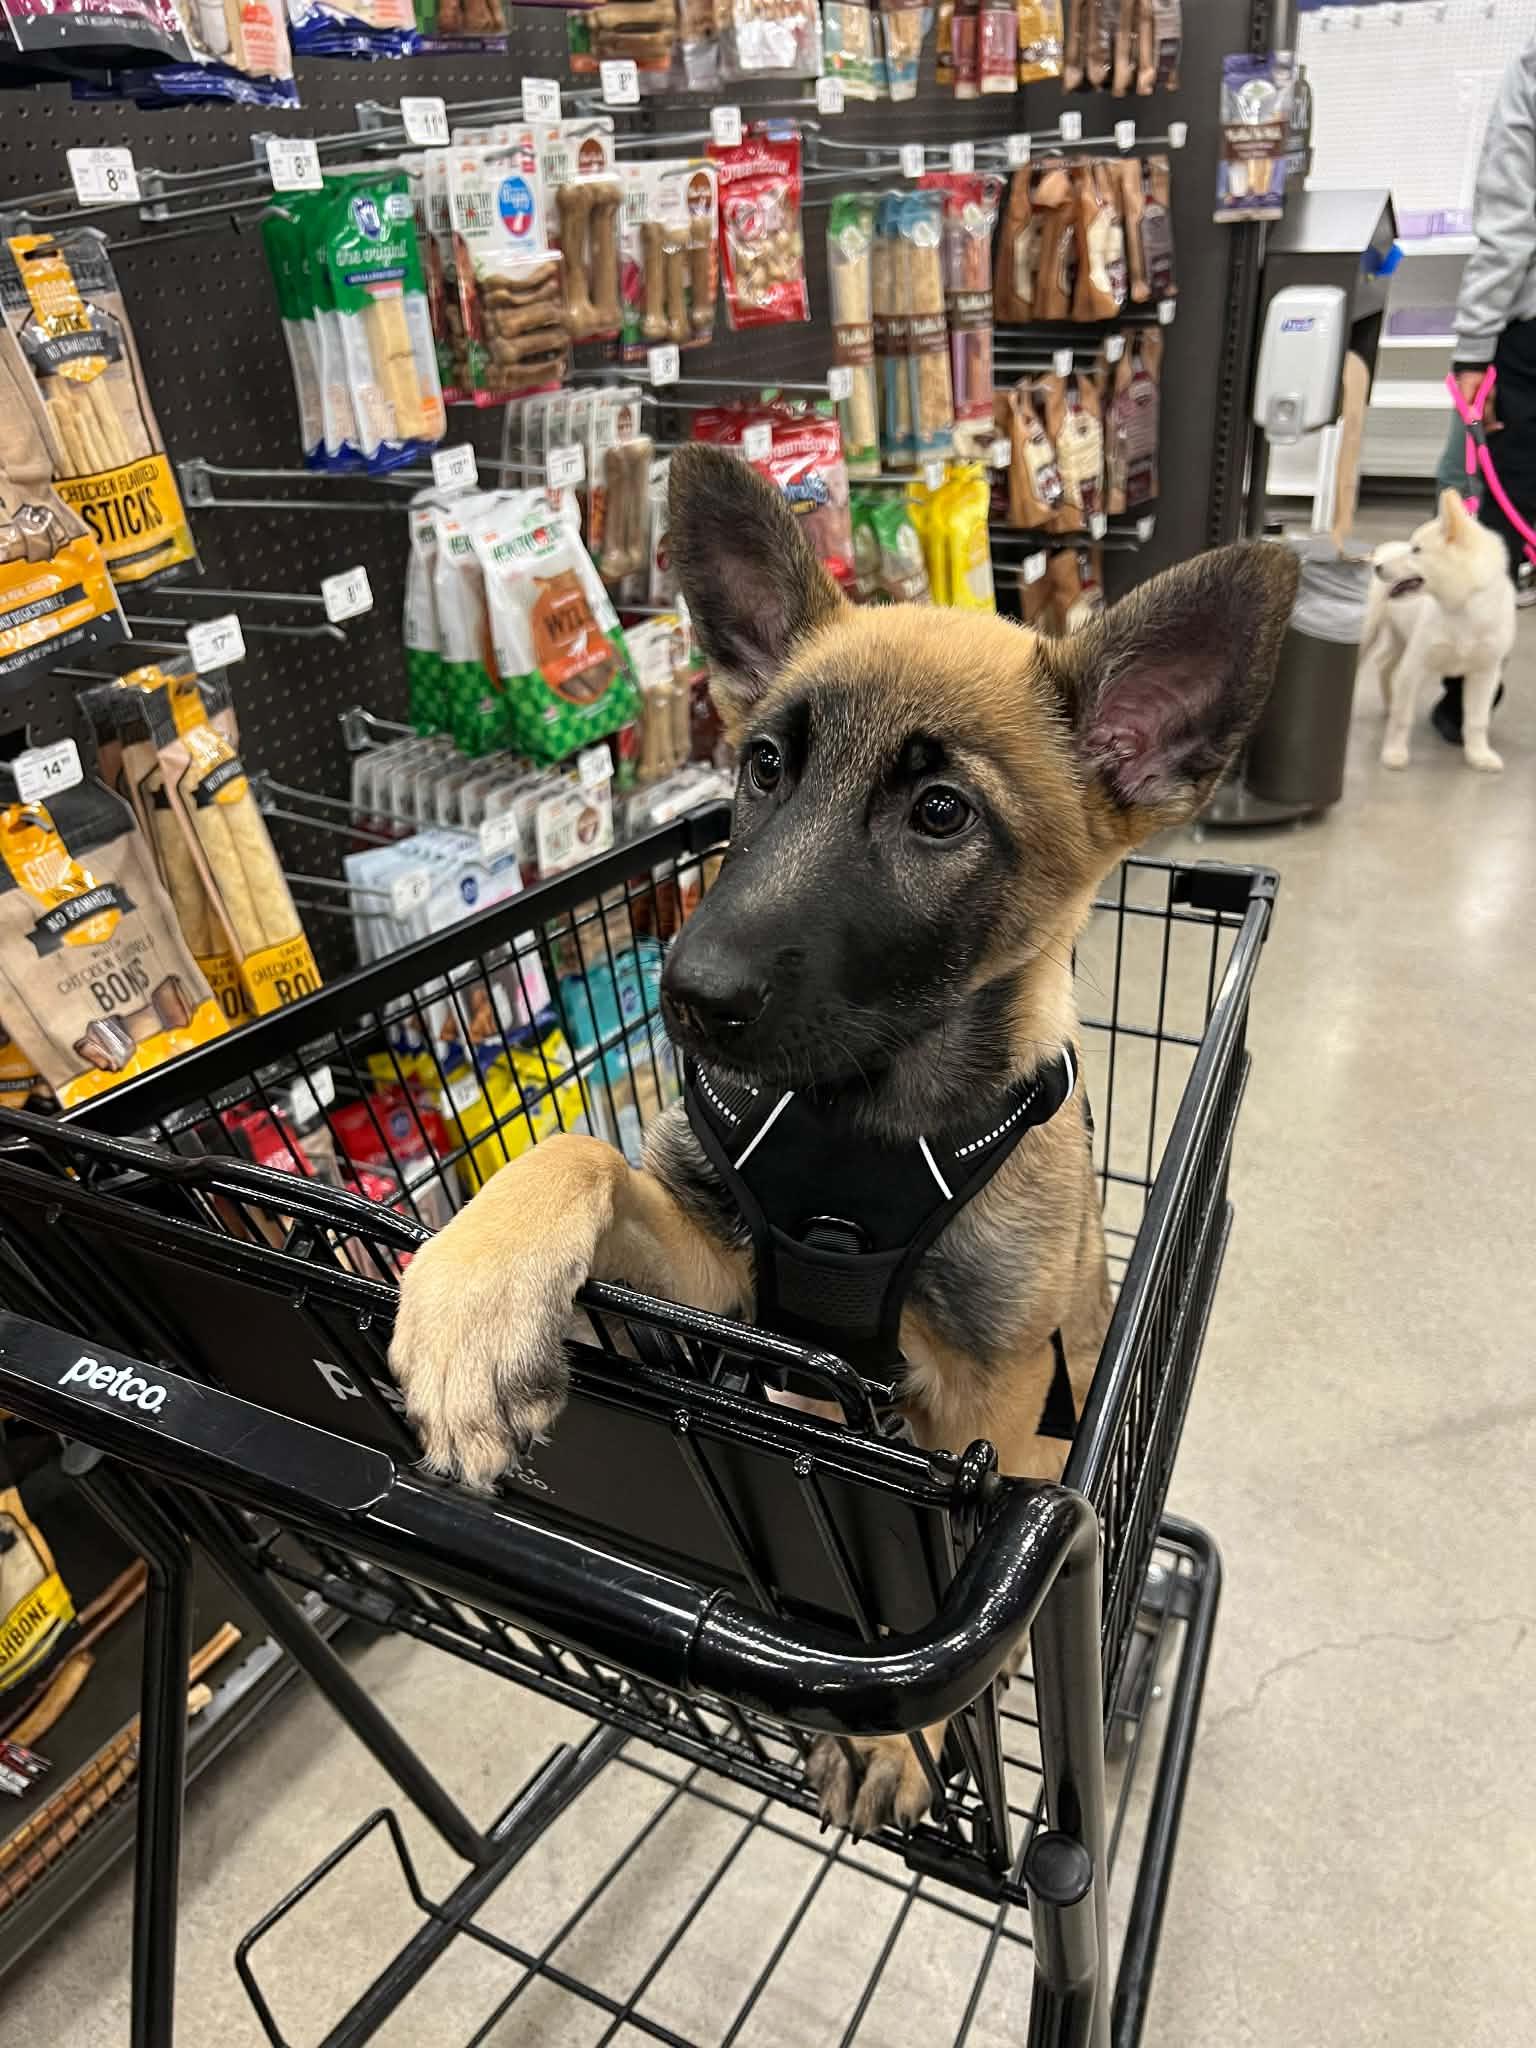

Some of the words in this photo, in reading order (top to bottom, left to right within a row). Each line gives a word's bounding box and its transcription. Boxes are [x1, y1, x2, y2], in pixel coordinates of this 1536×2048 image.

[106, 168, 119, 192] 8
[81, 486, 163, 545] STICKS
[43, 761, 63, 780] 14
[47, 912, 67, 931] NO
[58, 1355, 168, 1413] petco.
